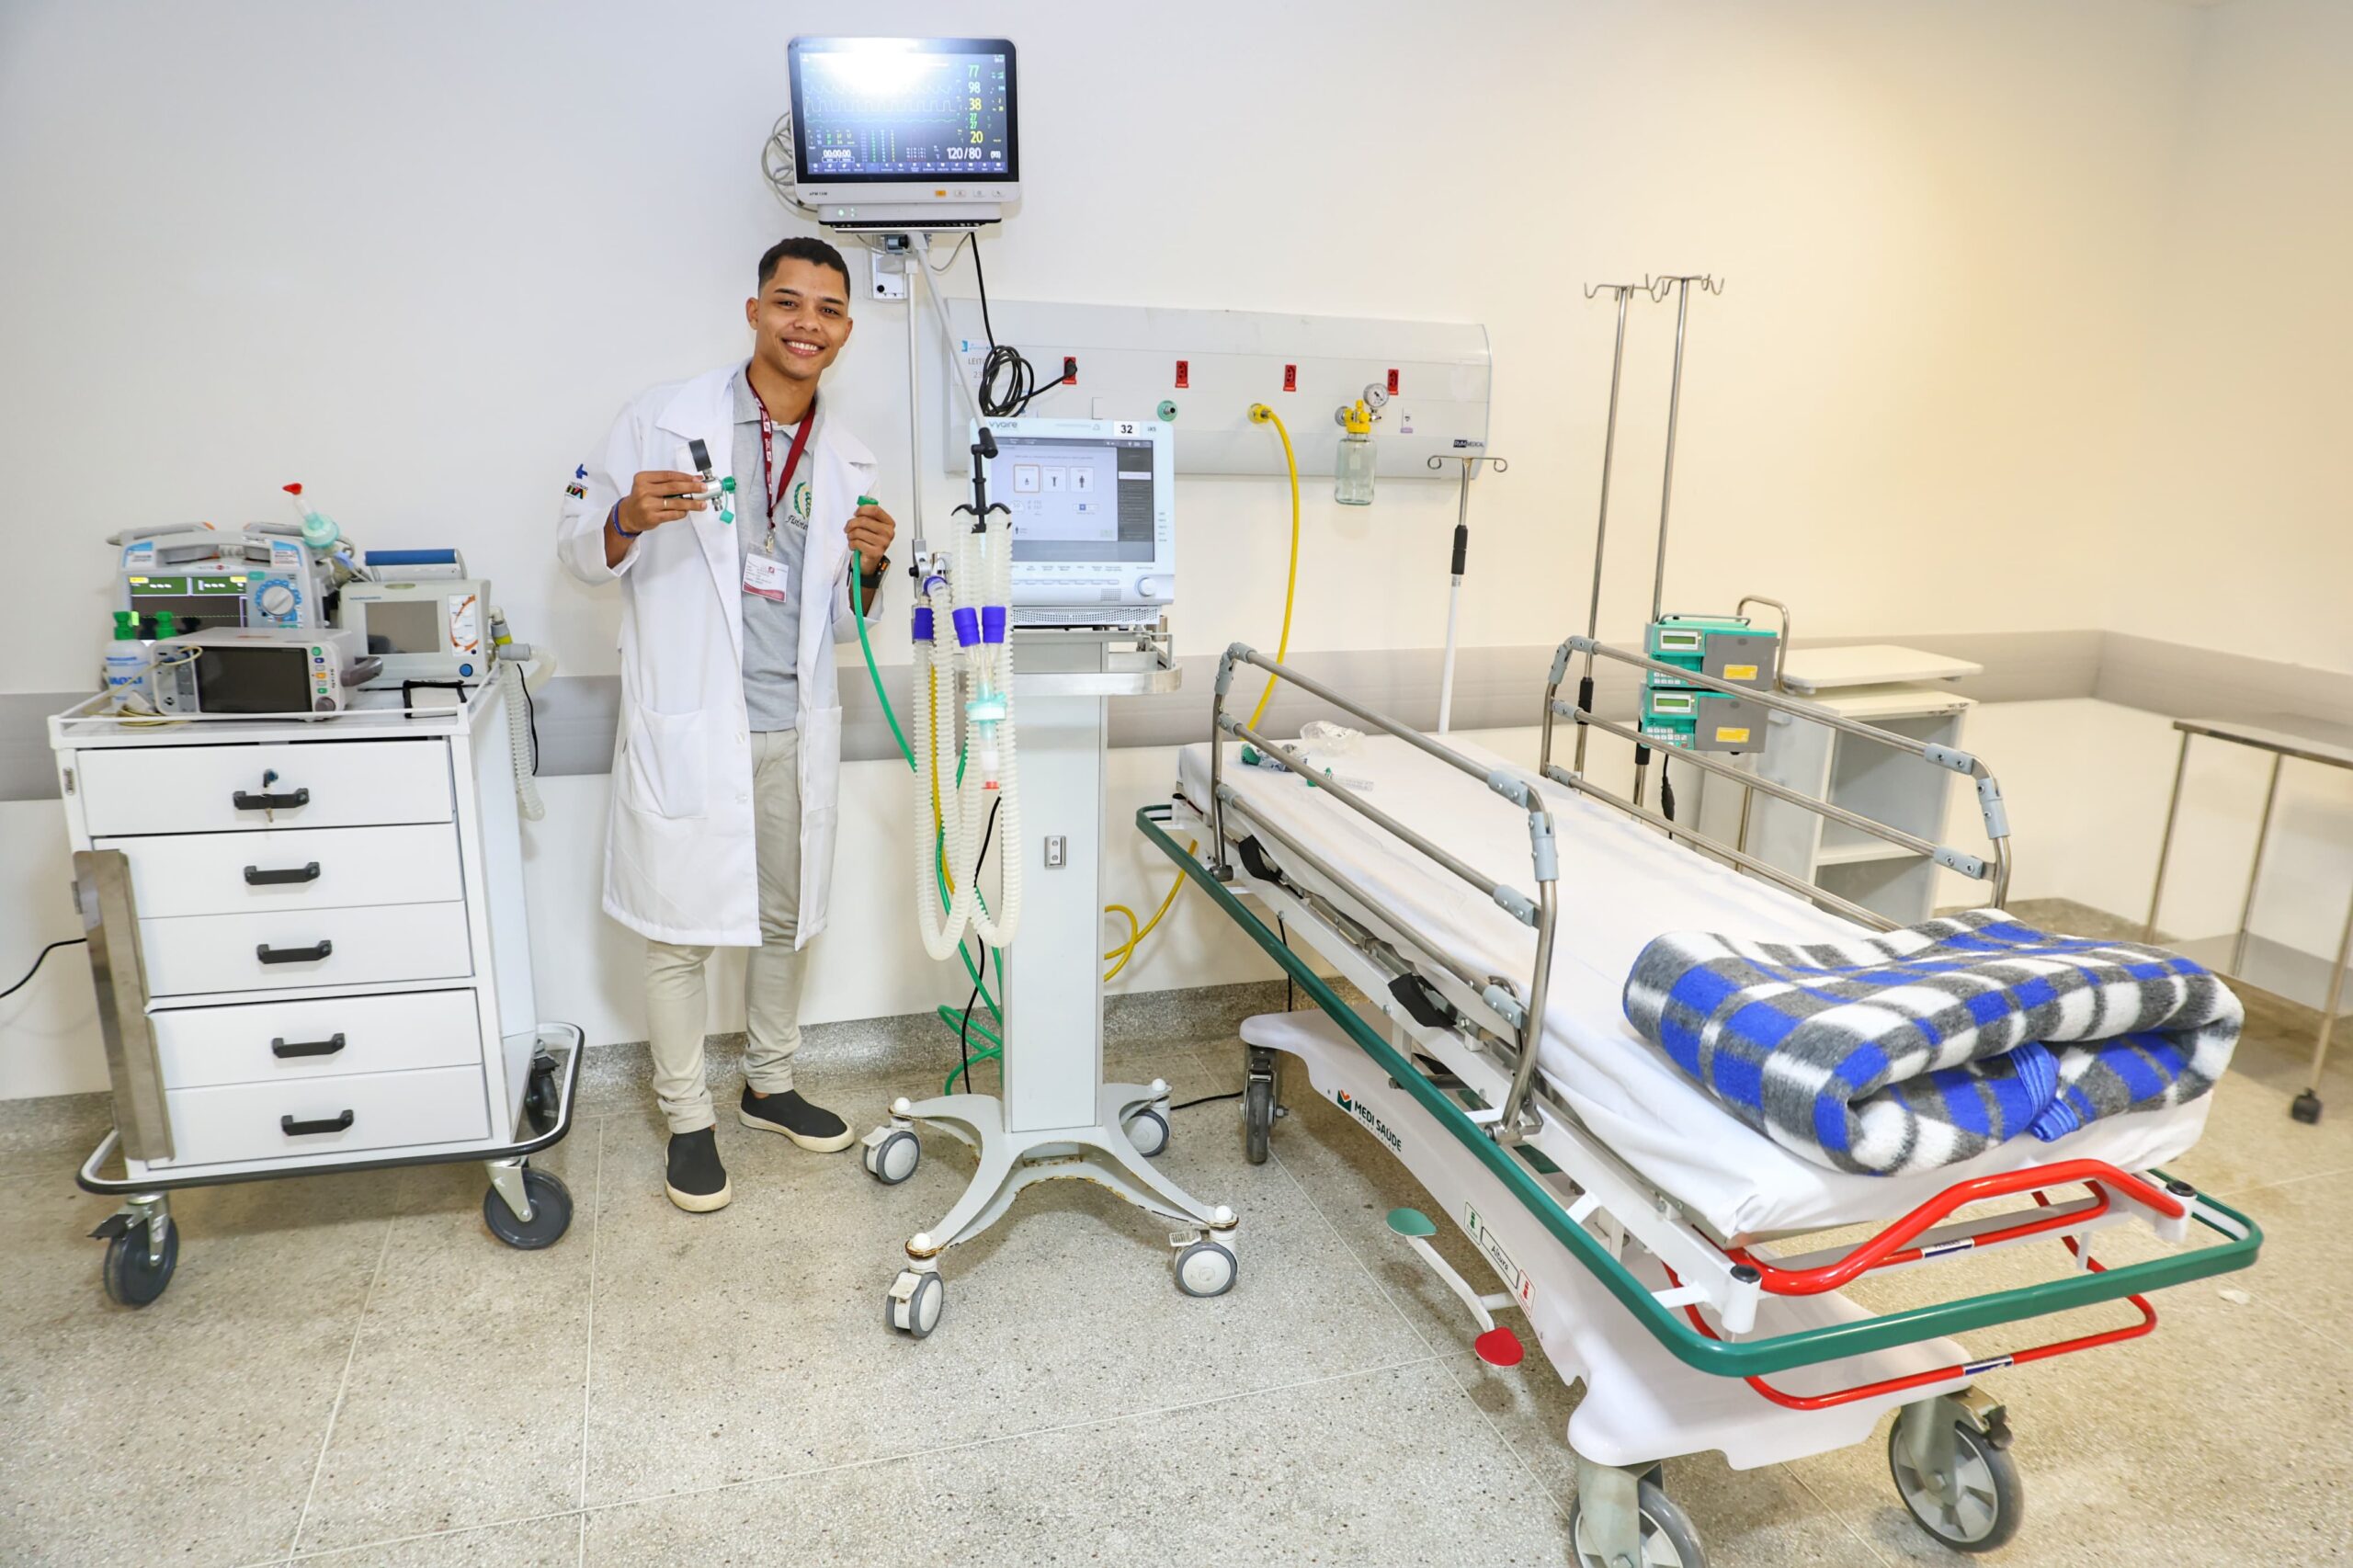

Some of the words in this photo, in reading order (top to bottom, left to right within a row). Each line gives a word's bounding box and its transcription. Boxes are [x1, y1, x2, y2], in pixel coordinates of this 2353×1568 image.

[968, 64, 980, 77] 77
[968, 81, 981, 94] 98
[969, 97, 982, 110] 38
[970, 131, 983, 143] 20
[947, 147, 982, 160] 120/80
[1120, 424, 1132, 434] 32
[1354, 1100, 1374, 1126] MEDI
[1376, 1119, 1402, 1153] SAÚDE
[1491, 1245, 1508, 1270] Altura
